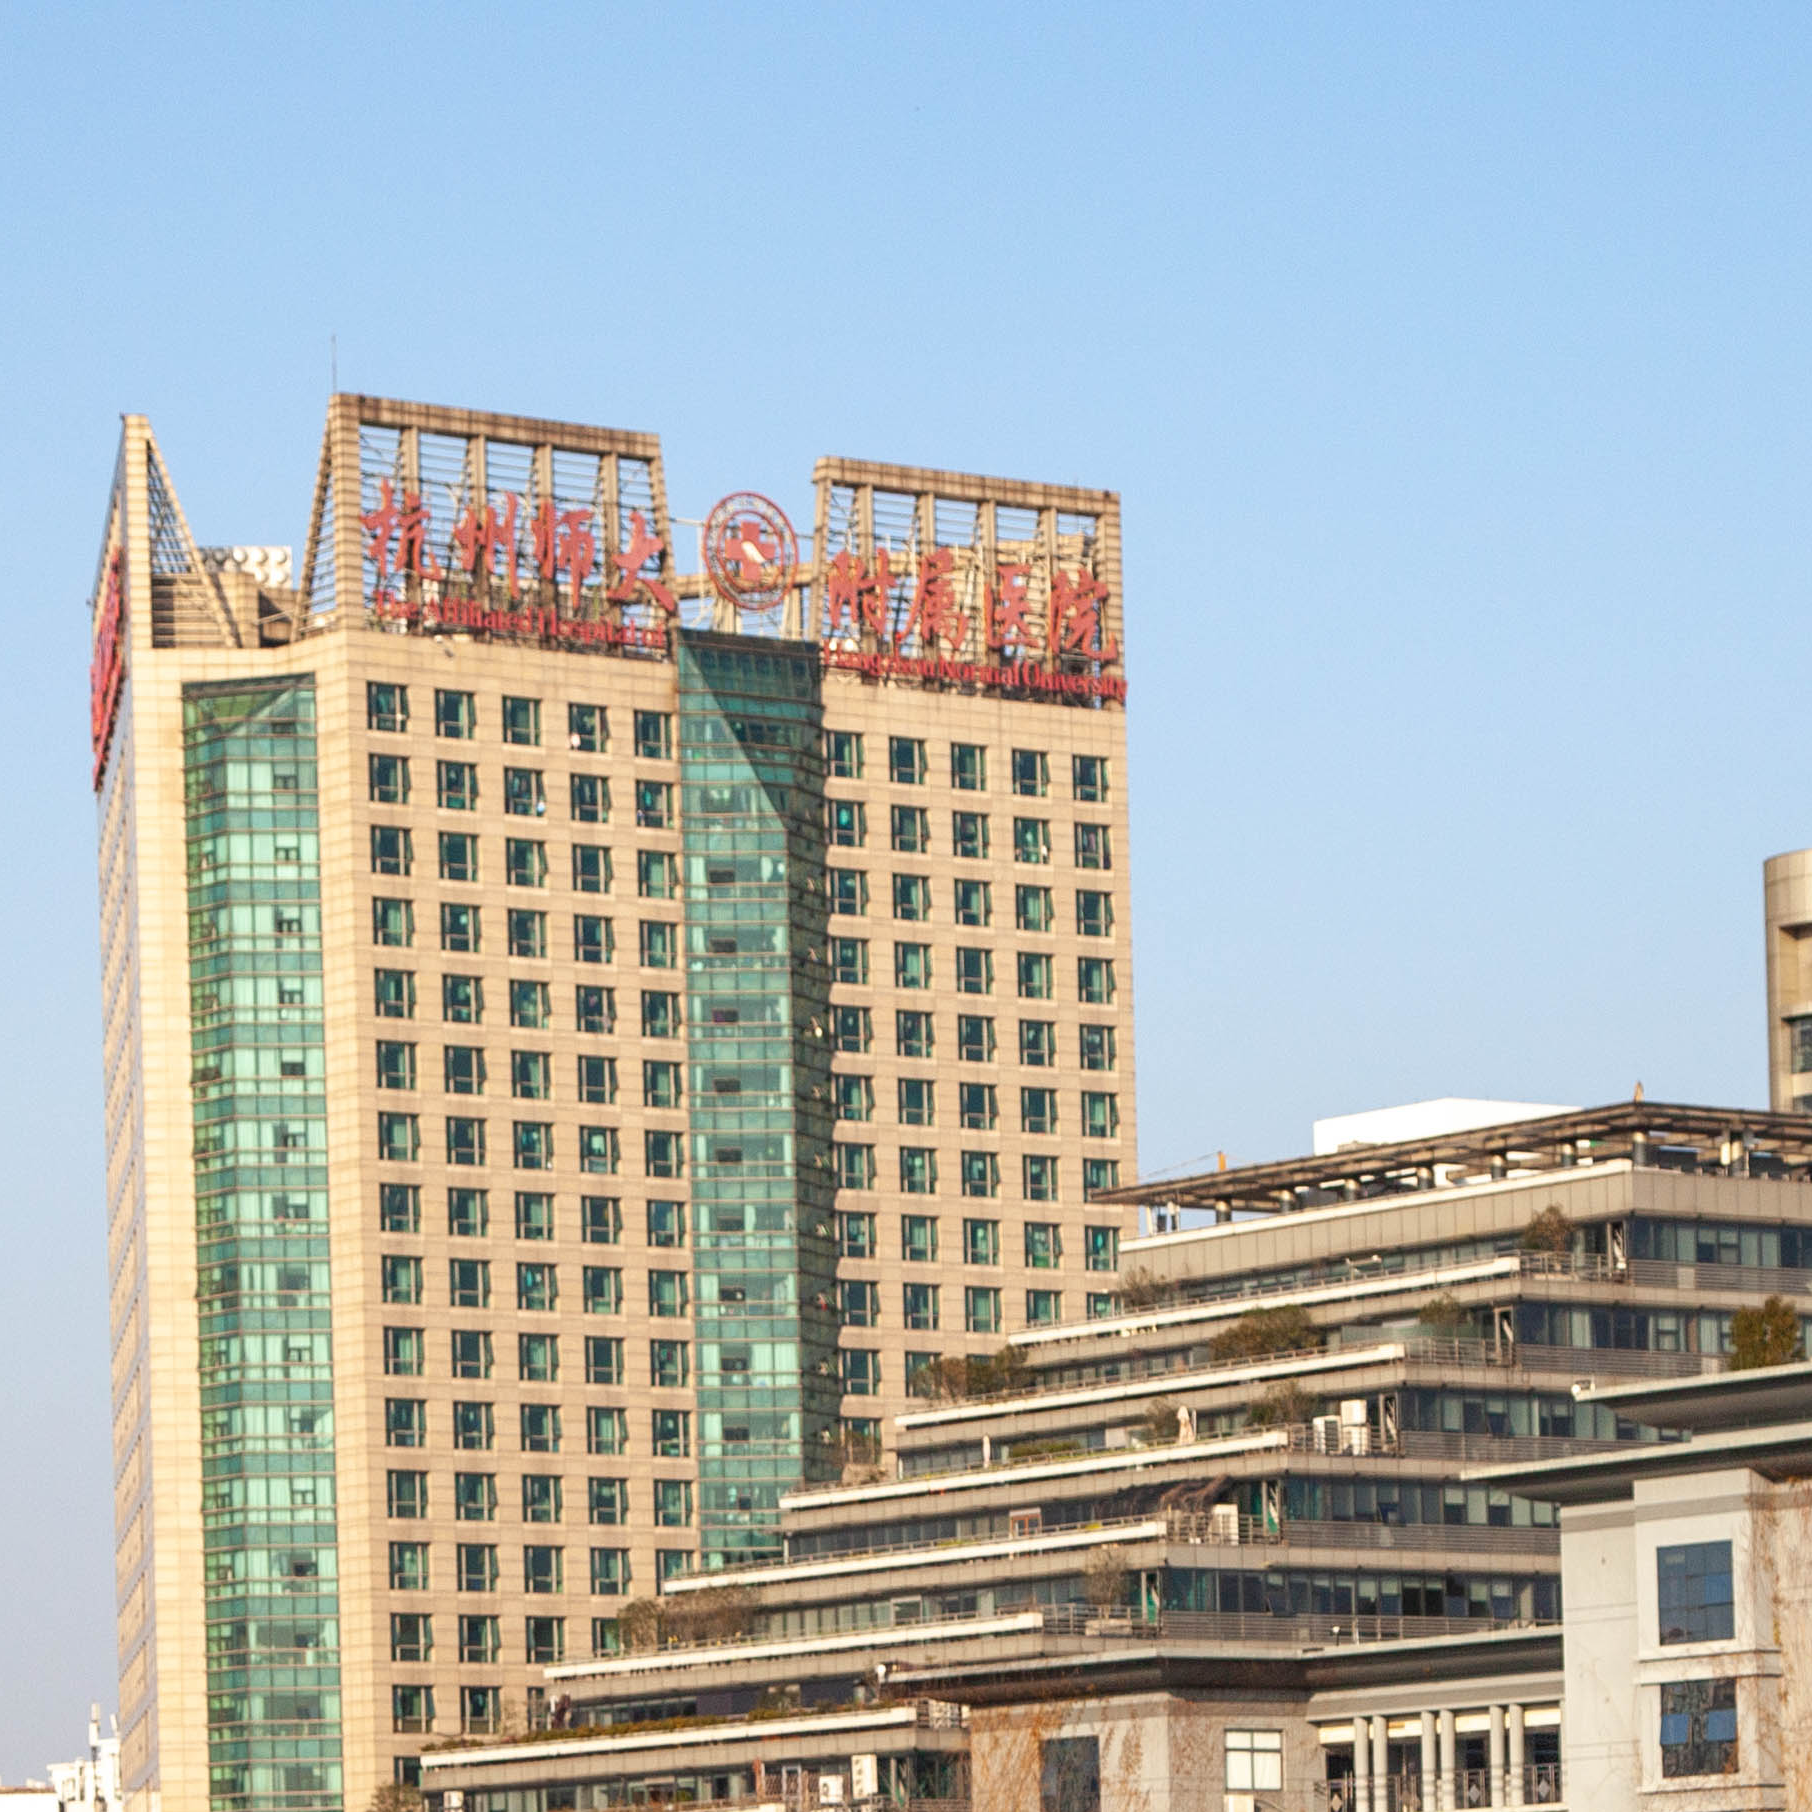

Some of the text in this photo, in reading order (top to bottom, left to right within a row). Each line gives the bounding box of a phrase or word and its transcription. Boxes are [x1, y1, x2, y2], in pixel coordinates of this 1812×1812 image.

[360, 478, 676, 612] 杭州师大
[373, 590, 666, 646] The Affiliated Hospital of
[828, 548, 1118, 661] 附属医院
[940, 655, 1020, 686] Normal
[1022, 660, 1127, 697] University
